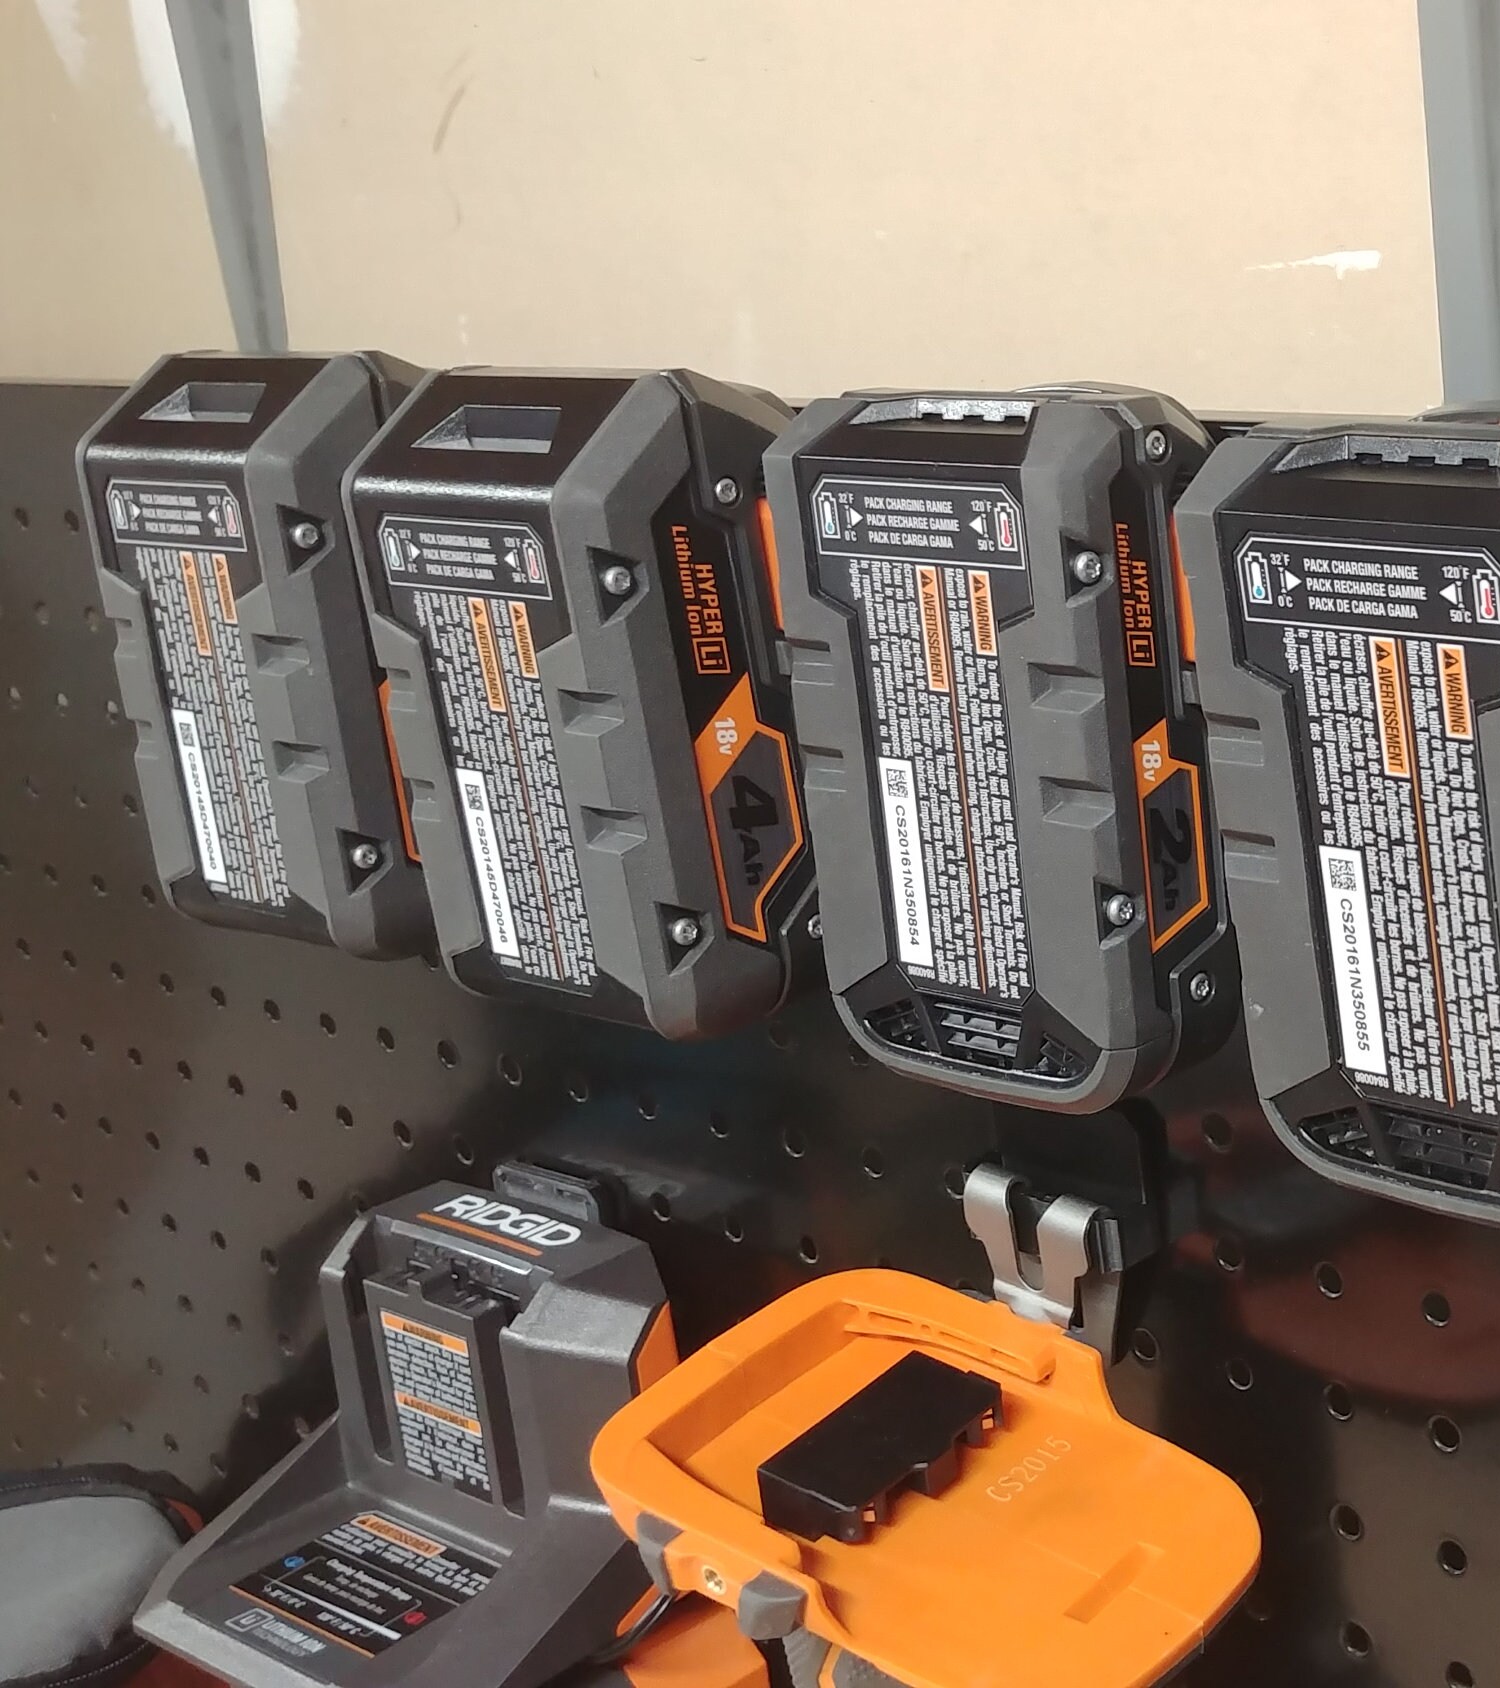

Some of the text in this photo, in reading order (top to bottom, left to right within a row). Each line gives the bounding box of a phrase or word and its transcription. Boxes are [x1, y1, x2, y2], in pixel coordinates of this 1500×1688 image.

[864, 497, 953, 514] PACK CHARGING RANGE
[672, 525, 702, 635] Lithium Ion
[1115, 523, 1136, 628] Lithium Ion
[1303, 558, 1419, 580] PACK CHARGING RANGE
[1306, 578, 1427, 601] PACK RECHARGE GAMME
[694, 564, 723, 635] HYPER
[1132, 561, 1152, 628] HYPER
[1309, 597, 1419, 619] PACK DE CARGA GAMA
[923, 591, 944, 685] AVERTISSEMENT
[975, 596, 993, 651] WARNING
[1310, 629, 1325, 664] Retirer
[1324, 630, 1338, 656] dans
[476, 622, 503, 706] AVERTISSEMENT
[516, 624, 536, 674] WARNING
[1418, 640, 1431, 674] expose
[1314, 677, 1329, 696] pile
[1330, 672, 1345, 710] manuel
[1425, 687, 1437, 709] rain,
[1445, 672, 1466, 733] WARNING
[1376, 665, 1403, 770] AVERTISSEMENT
[1428, 710, 1441, 737] water
[1323, 741, 1340, 783] pendant
[1431, 750, 1446, 783] liquids.
[1437, 785, 1450, 816] Follow
[1347, 803, 1362, 849] R840095.
[895, 805, 920, 946] CS20161N350854
[1340, 898, 1369, 1051] CS20161N350855
[433, 1194, 581, 1246] RIDGID
[986, 1435, 1071, 1501] CS2015
